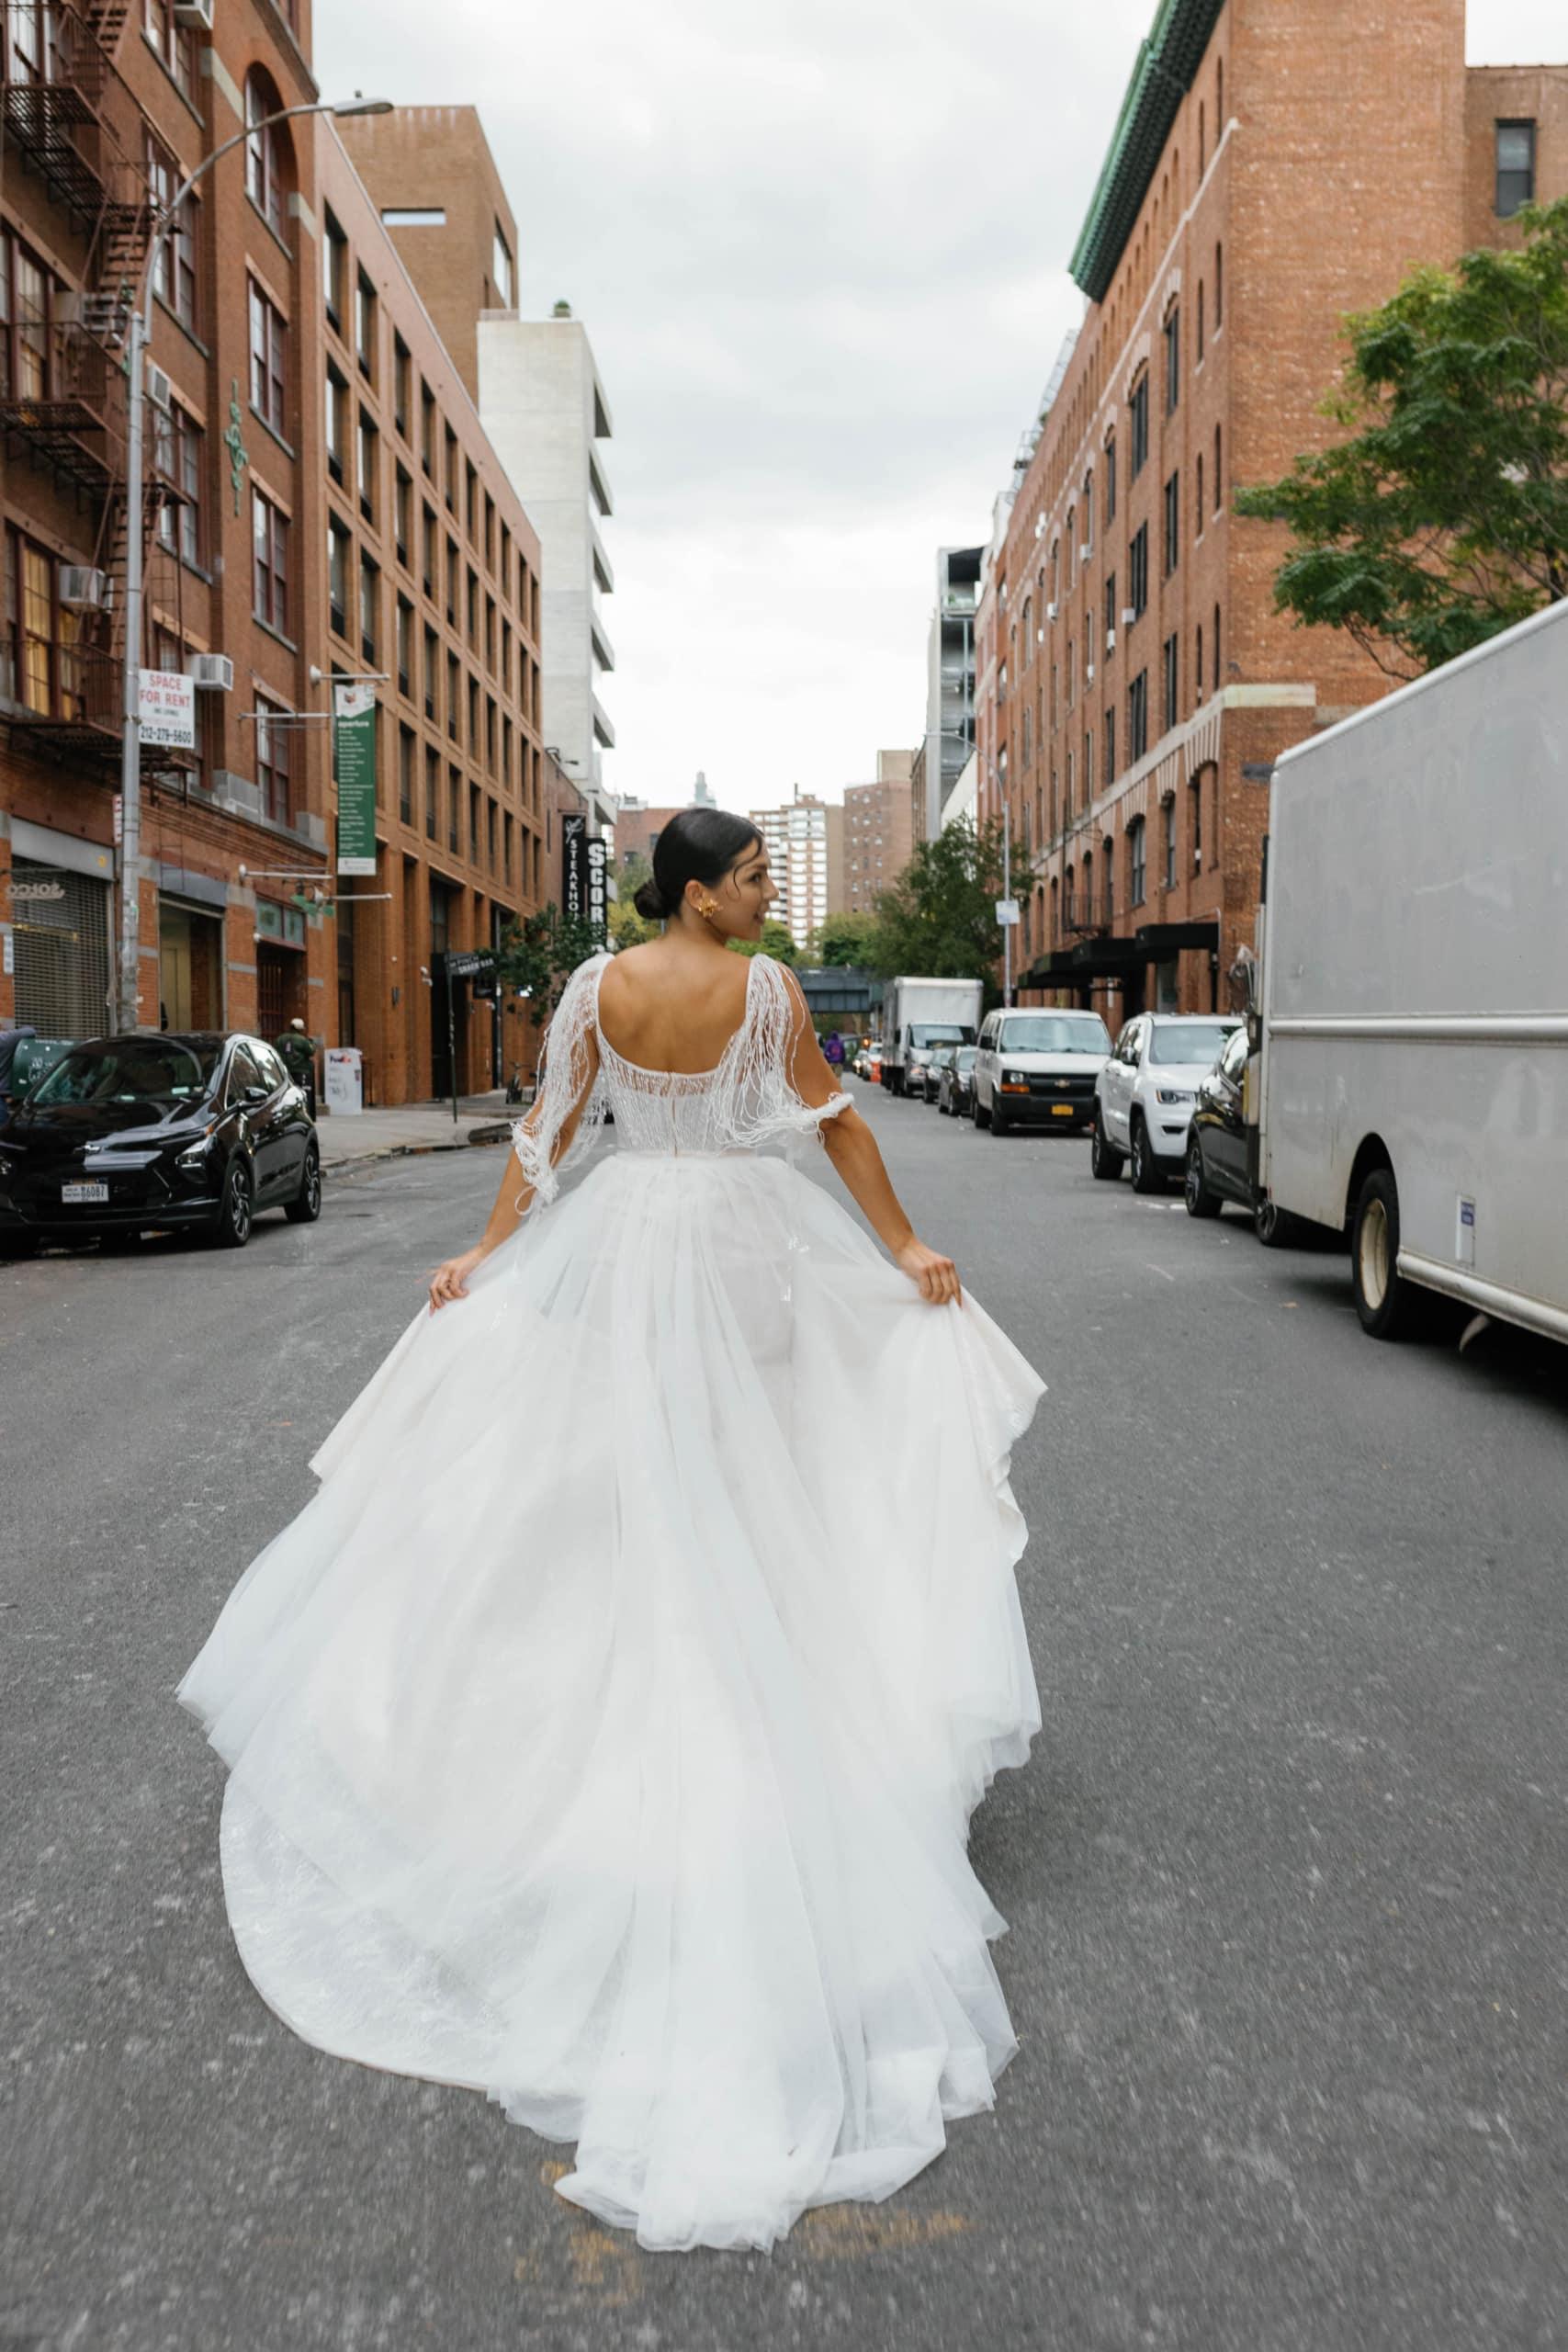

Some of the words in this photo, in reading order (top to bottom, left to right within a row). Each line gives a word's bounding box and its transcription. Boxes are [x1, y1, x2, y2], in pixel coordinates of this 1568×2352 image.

[149, 674, 182, 691] SPACE
[140, 689, 161, 705] FOR
[164, 693, 190, 707] RENT
[141, 726, 191, 743] 212-279-5600
[588, 842, 605, 954] SCOR
